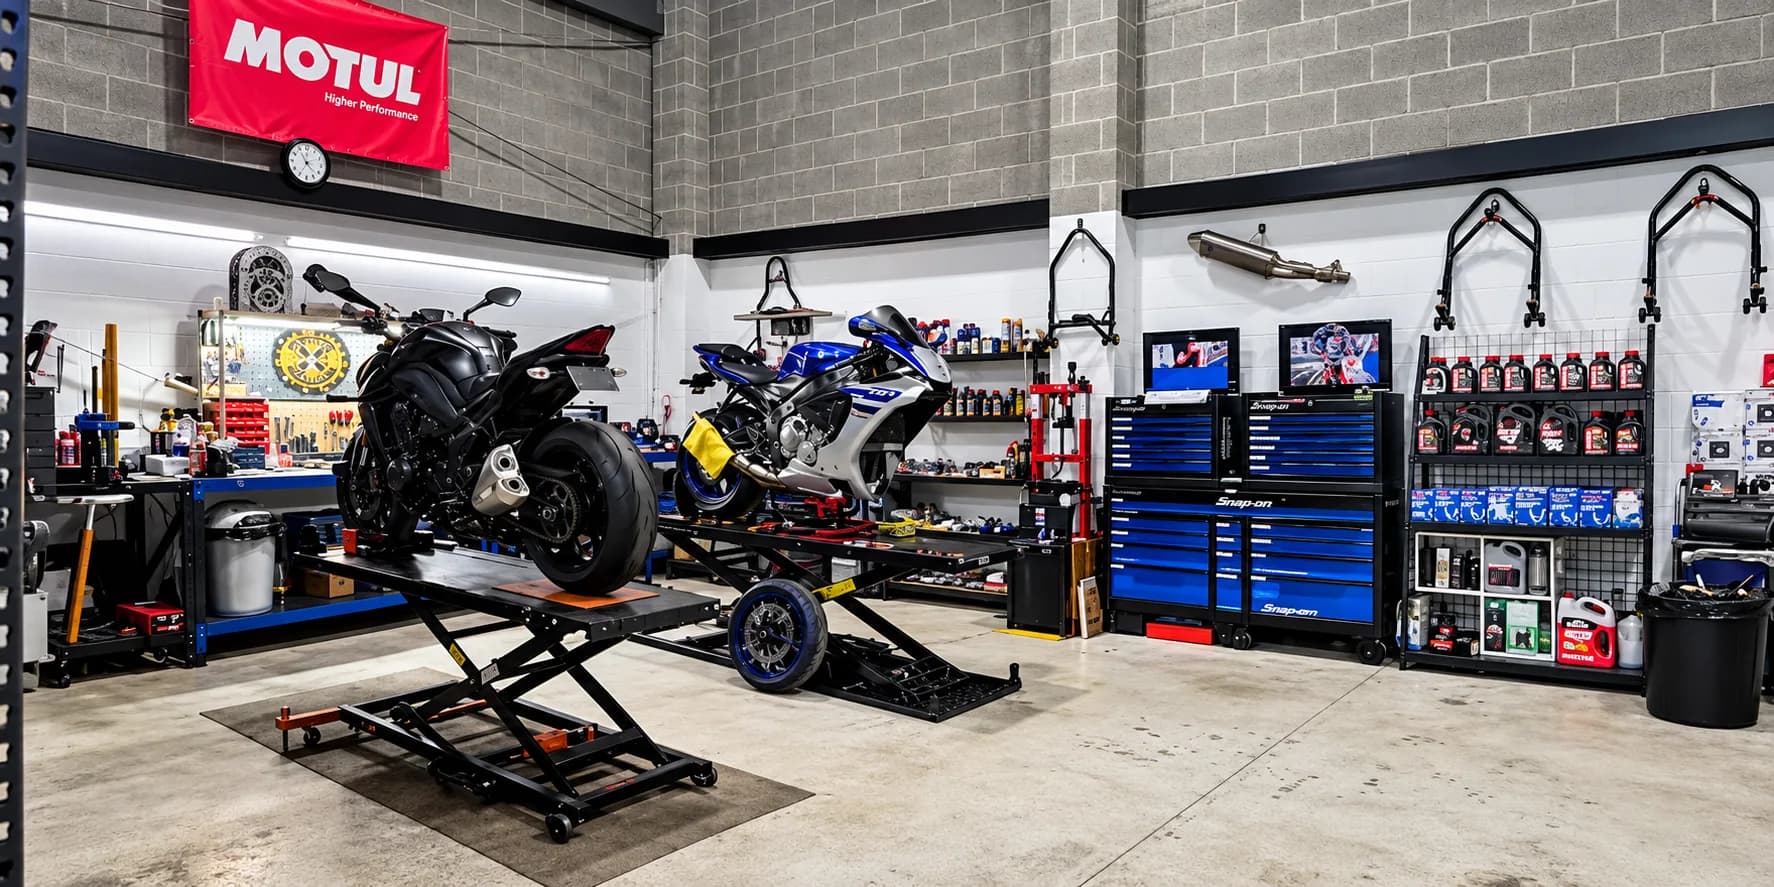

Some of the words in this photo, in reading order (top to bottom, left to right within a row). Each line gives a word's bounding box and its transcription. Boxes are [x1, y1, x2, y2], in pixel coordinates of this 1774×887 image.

[224, 18, 421, 106] MOTUL
[324, 92, 357, 109] Higher
[359, 100, 419, 122] Performance
[1215, 496, 1273, 509] Snap-on
